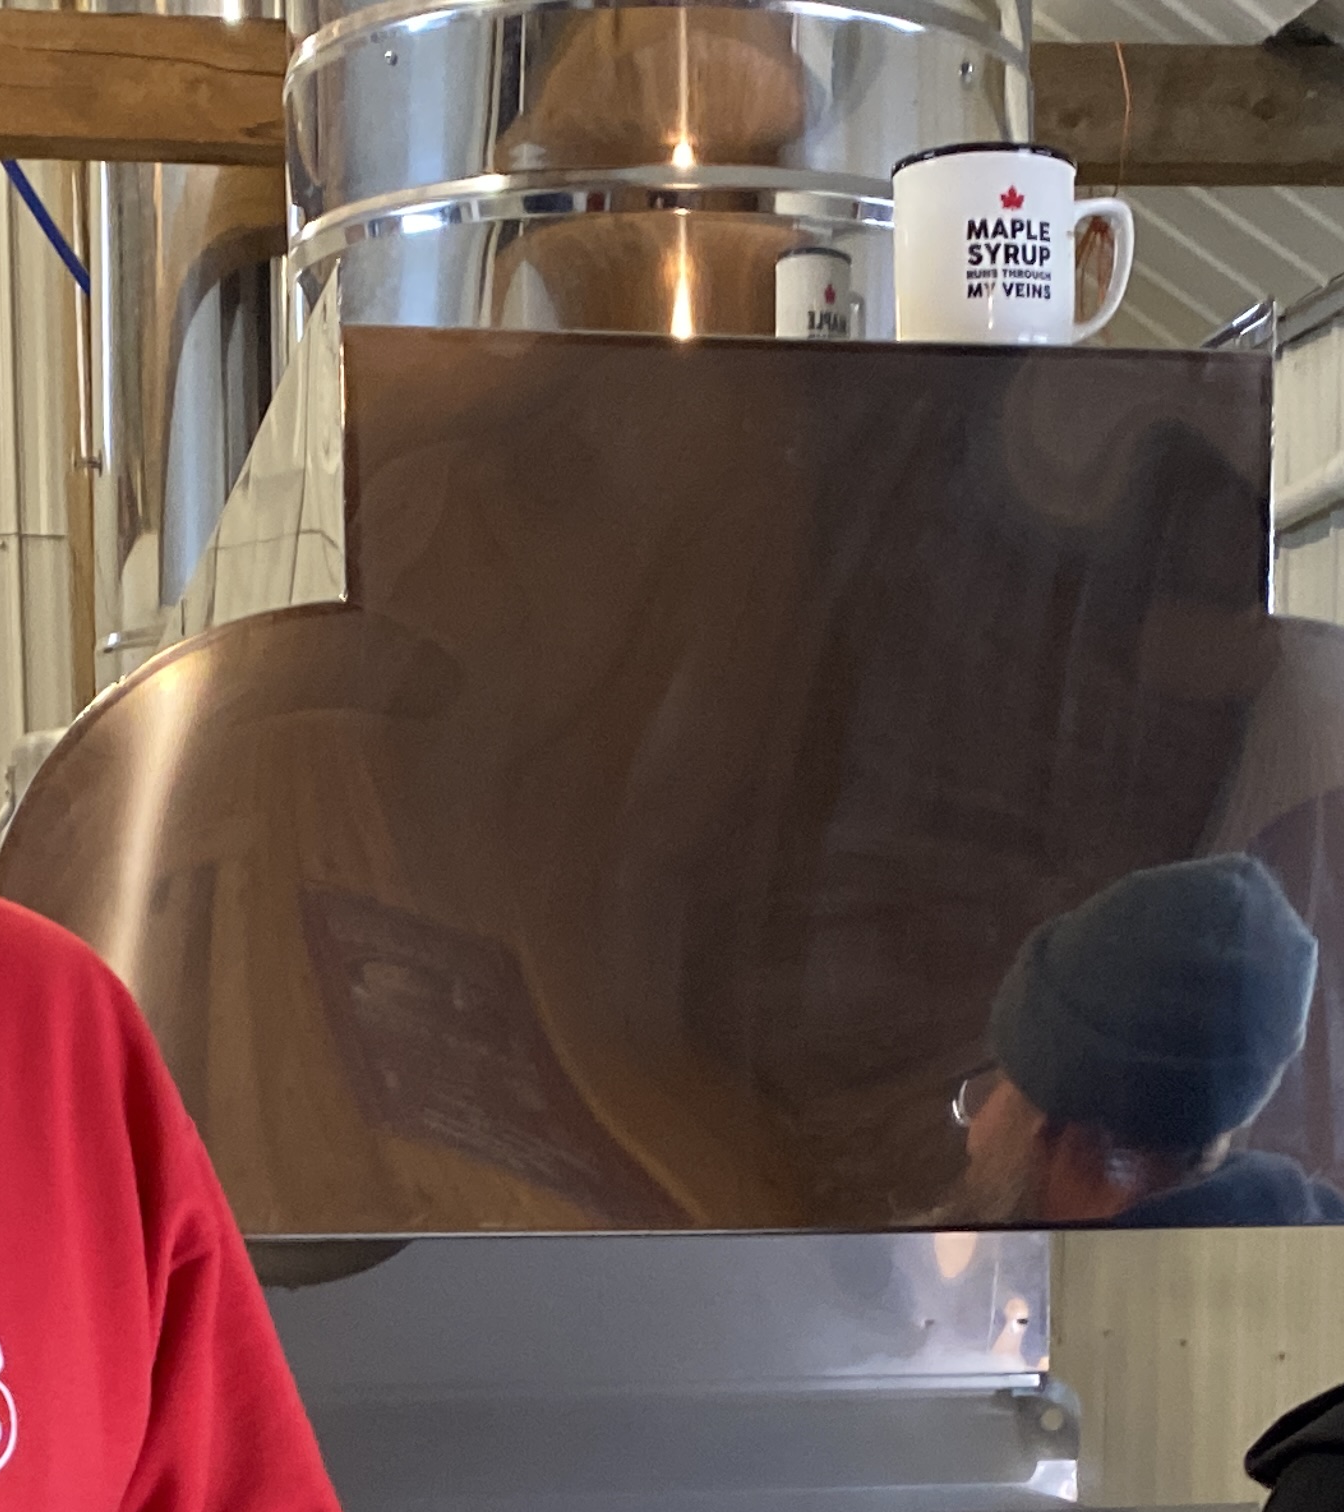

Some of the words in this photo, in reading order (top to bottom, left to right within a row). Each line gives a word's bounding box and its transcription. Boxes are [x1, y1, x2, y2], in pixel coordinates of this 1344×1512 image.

[966, 217, 1051, 242] MAPLE
[967, 242, 1051, 267] SYRUP
[1002, 268, 1052, 282] THROUGH
[967, 282, 996, 299] MY
[1002, 282, 1051, 300] VEINS
